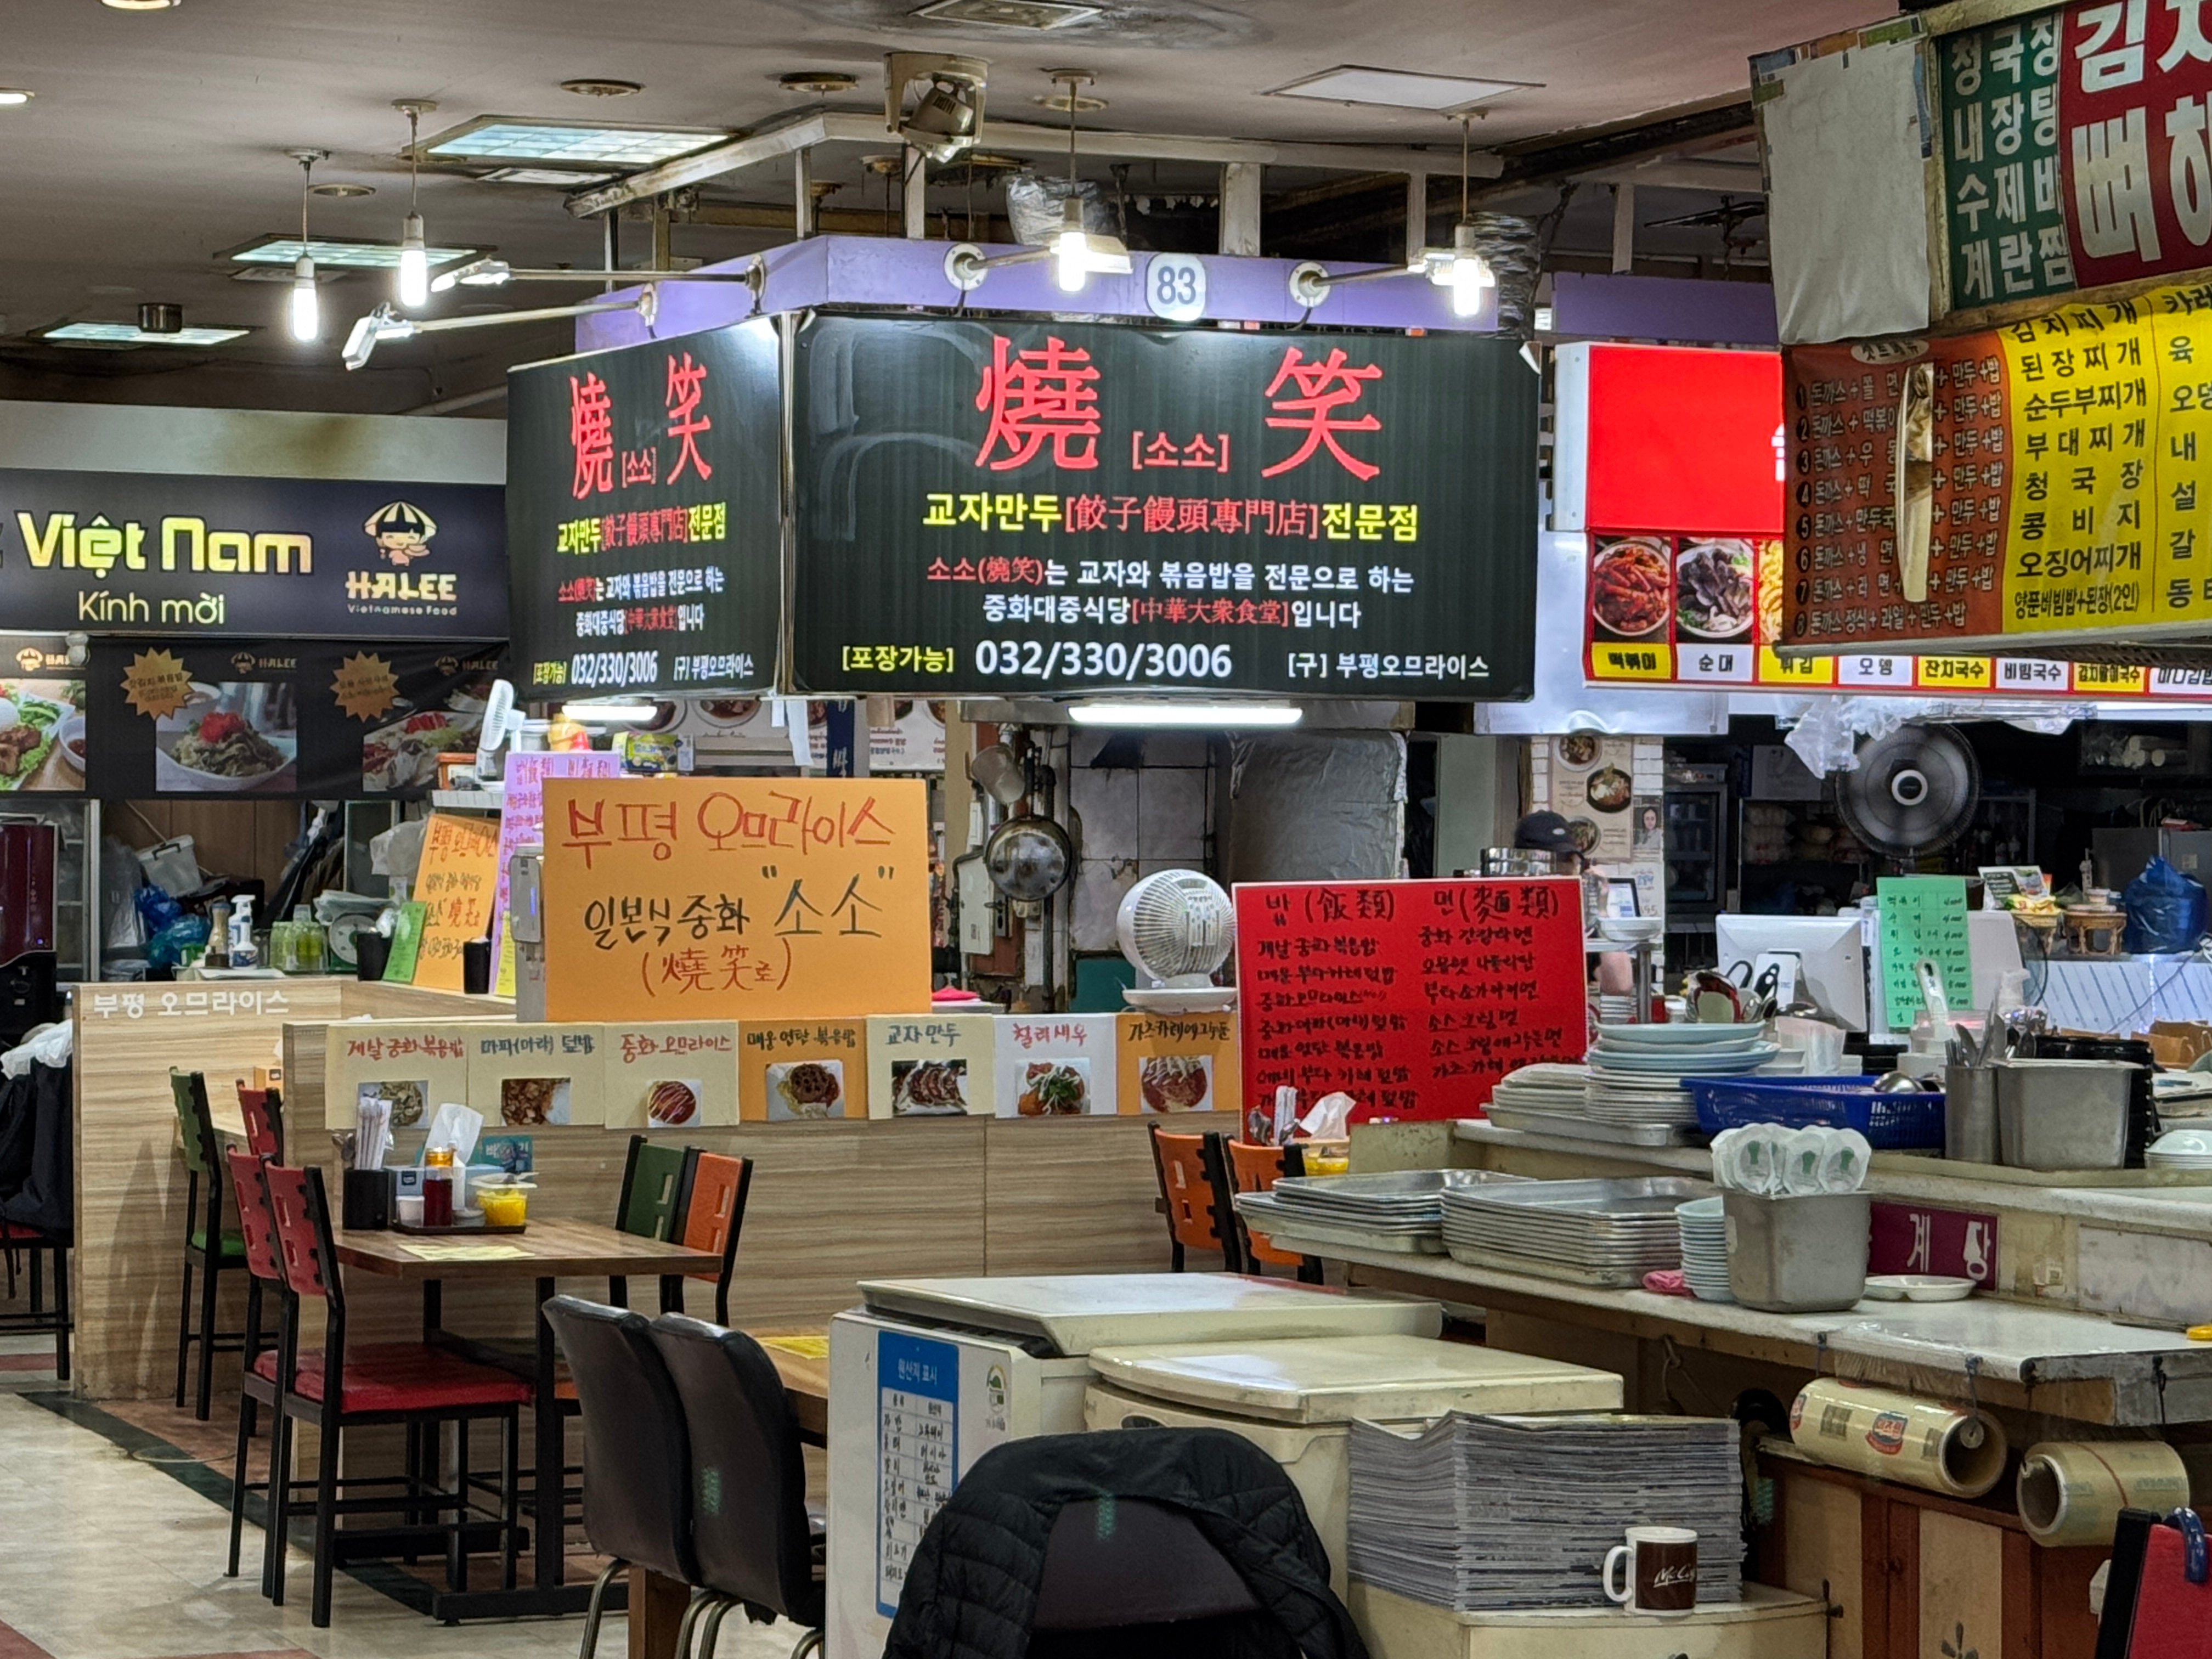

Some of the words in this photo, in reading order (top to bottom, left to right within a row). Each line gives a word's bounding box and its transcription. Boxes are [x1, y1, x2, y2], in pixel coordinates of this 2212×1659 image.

[1952, 12, 2059, 95] 청국장
[1953, 83, 2058, 163] 내장탕
[1957, 154, 2061, 232] 수제비
[1157, 266, 1196, 304] 83
[2021, 337, 2141, 382] 된장찌개
[665, 352, 712, 485] 笑
[975, 336, 1101, 473] 燒
[1261, 347, 1384, 481] 笑
[2024, 377, 2146, 422] 순두부찌개
[622, 448, 657, 489] [소소]
[1131, 432, 1229, 471] [소소]
[17, 512, 146, 579] Việt
[161, 517, 312, 573] Nam
[2016, 540, 2141, 578] 오징어찌개
[345, 571, 457, 600] HALEE
[606, 573, 630, 601] 교자와
[633, 570, 666, 600] 볶음밥을
[668, 568, 703, 596] 전문으로
[704, 566, 725, 594] 하는
[1077, 560, 1151, 589] 교자와
[1160, 561, 1256, 590] 볶음밥을
[1264, 563, 1358, 591] 전문으로
[1368, 566, 1414, 594] 하는
[78, 591, 149, 623] Kính
[161, 592, 225, 624] mời
[347, 604, 423, 614] Vietnamese
[426, 605, 457, 616] Food
[571, 651, 658, 688] 032/330/3006
[691, 653, 754, 680] 부평오므라이스
[842, 645, 955, 674] [포장가능]
[975, 639, 1232, 680] 032/330/3006
[1288, 652, 1328, 679] [구]
[1336, 652, 1489, 679] 부평오므라이스
[1608, 652, 1656, 670] 떡볶이
[1926, 659, 1984, 679] 잔치국수
[2005, 662, 2062, 681] 비빔국수
[562, 797, 677, 870] 부평
[697, 791, 896, 855] 오므라이스
[584, 895, 673, 950] 일본식
[678, 893, 752, 940] 중화
[1265, 893, 1291, 926] 밥
[94, 993, 145, 1019] 부평
[157, 990, 290, 1015] 오므라이스
[620, 1032, 658, 1064] 중화
[898, 1358, 921, 1383] 원산지
[922, 1364, 938, 1386] 표시
